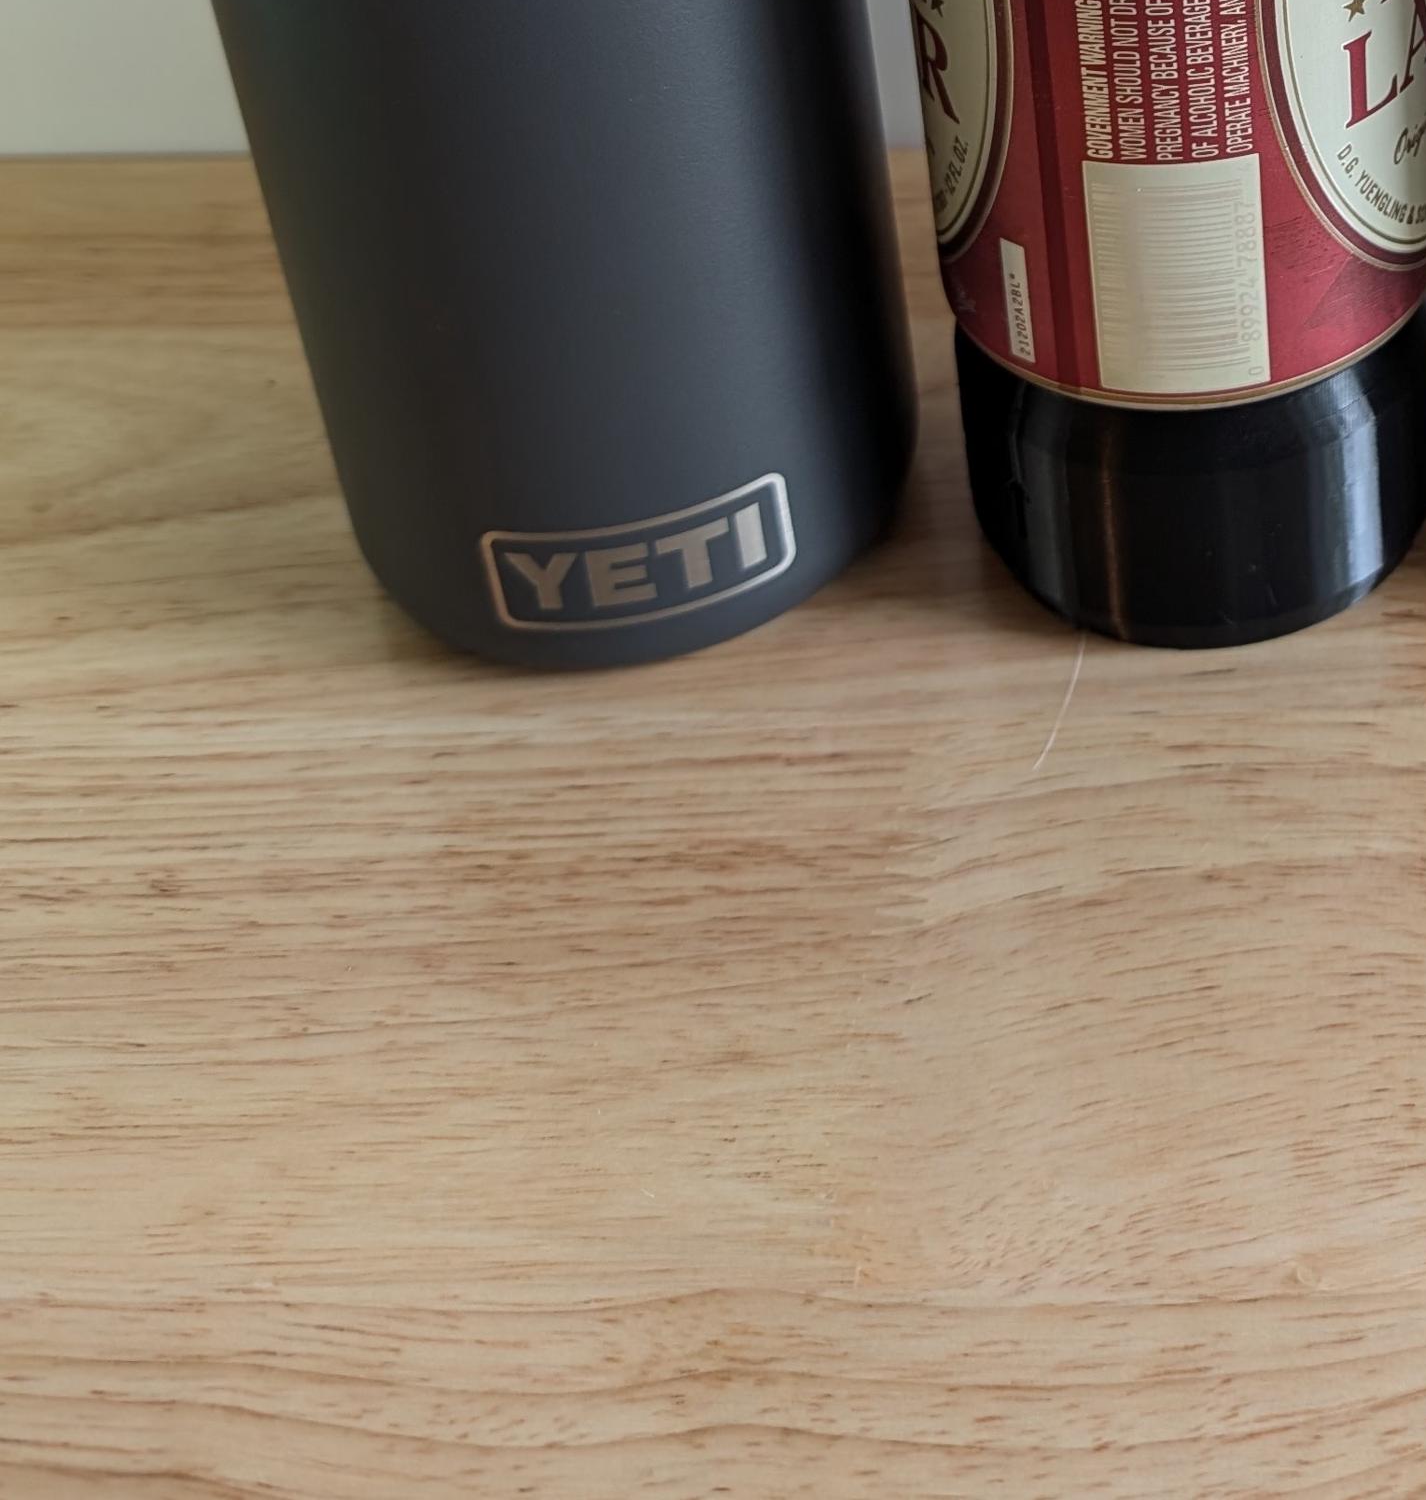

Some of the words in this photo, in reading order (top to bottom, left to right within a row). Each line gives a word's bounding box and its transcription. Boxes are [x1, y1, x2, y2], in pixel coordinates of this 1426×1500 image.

[1112, 51, 1143, 104] SHOULD
[1147, 19, 1178, 80] BECAUSE
[1080, 67, 1114, 159] GOVERNMENT
[1117, 107, 1147, 160] WOMEN
[1152, 83, 1183, 160] PREGNANCY
[1186, 66, 1217, 137] ALCOHOLIC
[1225, 98, 1253, 154] OPERATE
[1354, 169, 1407, 223] YUENGLING
[1233, 202, 1258, 268] 78887
[1239, 277, 1262, 342] 89924
[504, 502, 767, 610] YETI
